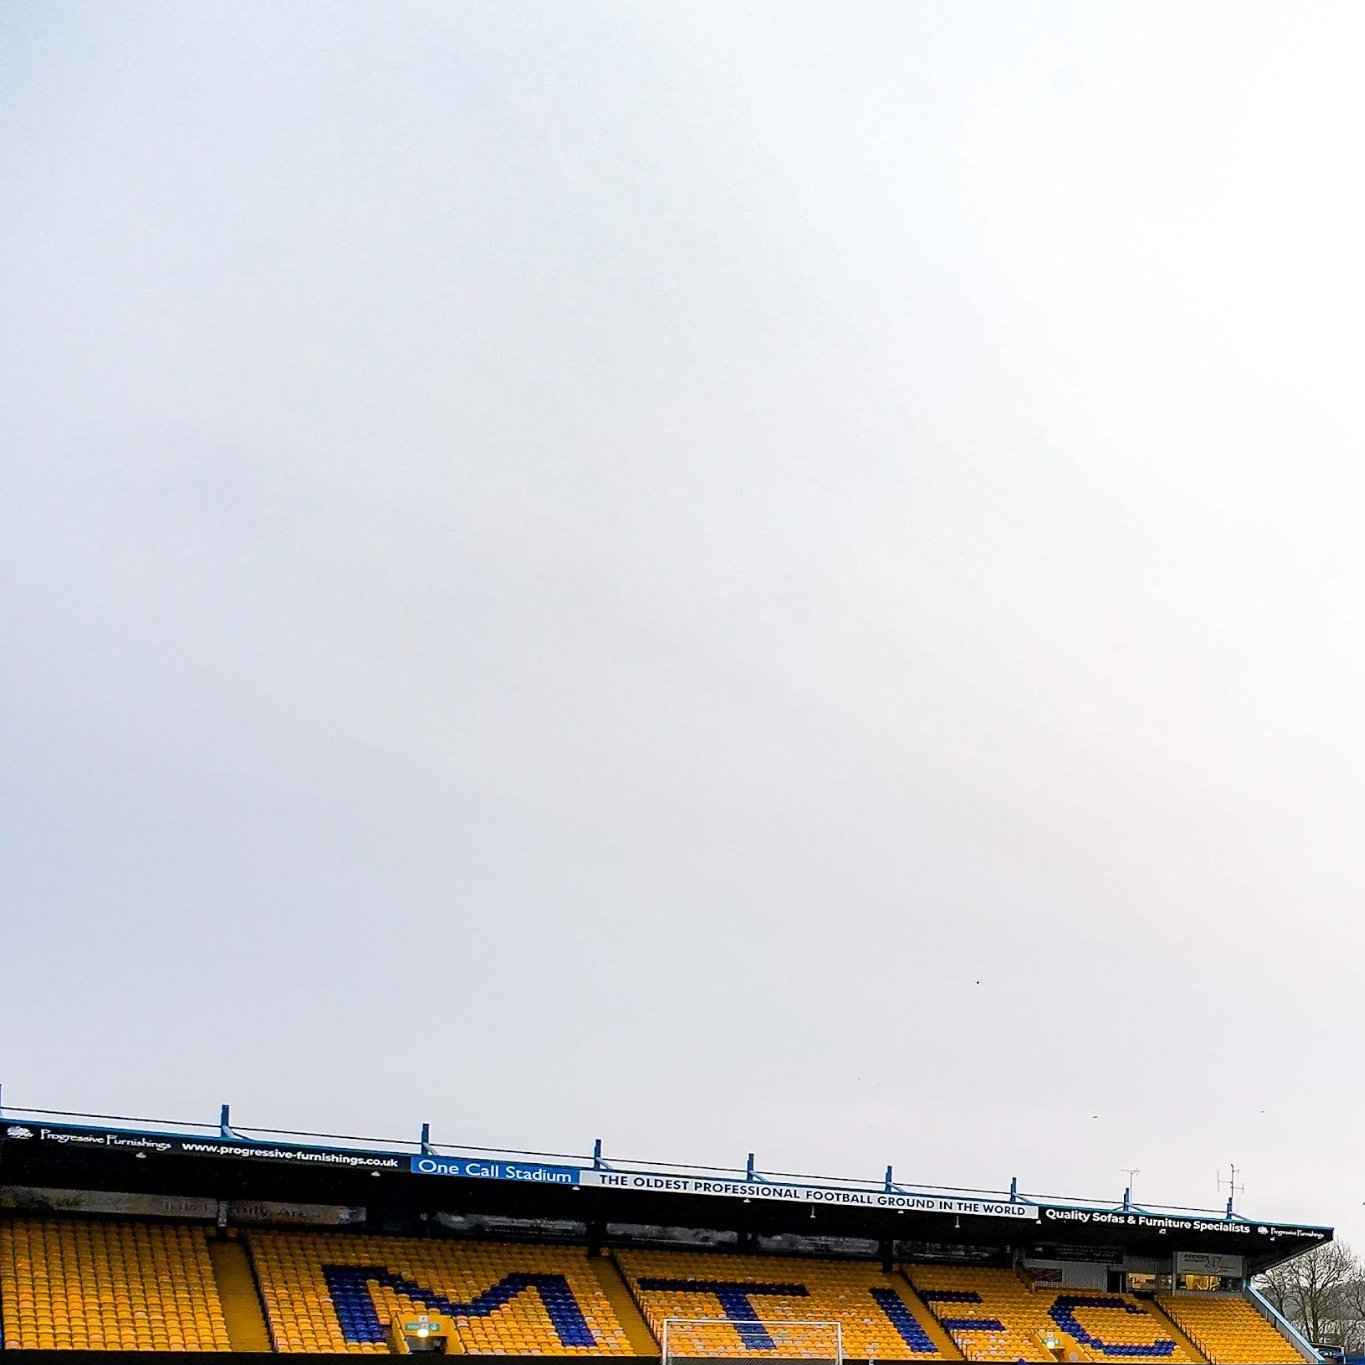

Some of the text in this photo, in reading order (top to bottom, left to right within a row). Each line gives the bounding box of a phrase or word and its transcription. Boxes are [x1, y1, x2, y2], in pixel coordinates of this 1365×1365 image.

[40, 1128, 172, 1151] Progressive Furnishings
[181, 1142, 399, 1167] www.progressive-furnishings.co.uk
[418, 1159, 572, 1183] One Call Stadium
[599, 1174, 1026, 1216] THE OLDEST PROFESSIONAL FOOTBALL GROUND IN THE WORLD
[1045, 1208, 1251, 1234] Quality Sofas & Furniture Specialists
